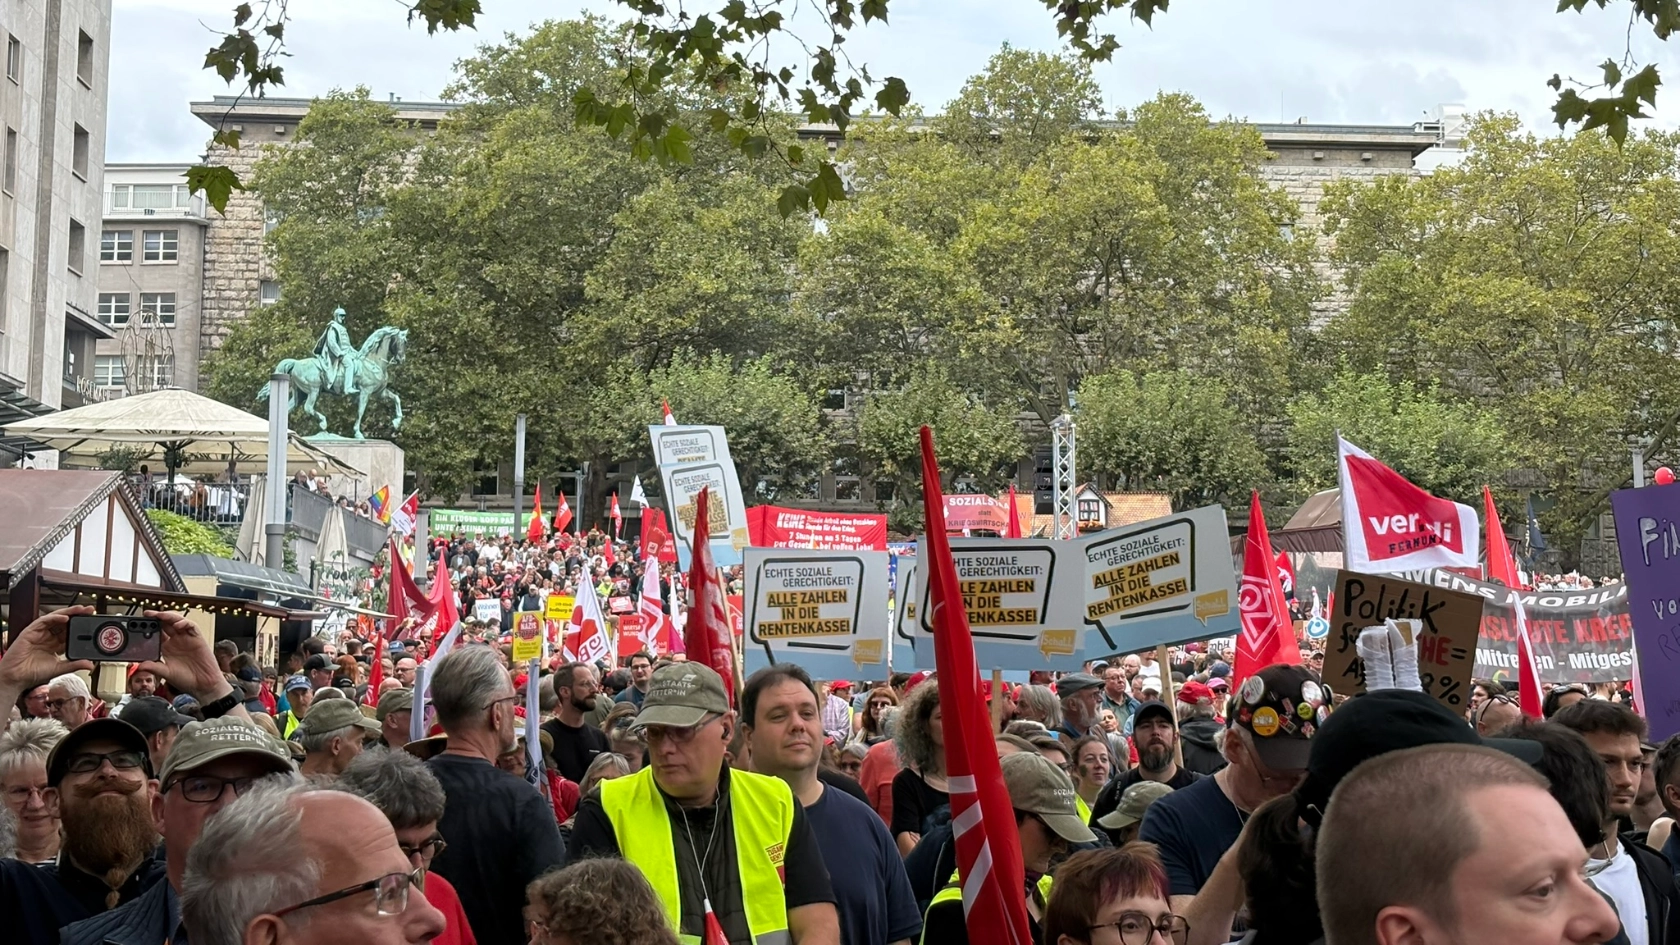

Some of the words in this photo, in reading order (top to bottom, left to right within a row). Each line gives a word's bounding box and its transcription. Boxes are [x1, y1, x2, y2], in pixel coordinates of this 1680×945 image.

[662, 440, 679, 449] ECHTE
[680, 438, 698, 447] SOZIALE
[675, 477, 691, 487] ECHTE
[691, 473, 710, 483] SOZIALE
[841, 535, 861, 543] Tagen
[1088, 547, 1118, 563] ECHTE
[1120, 535, 1160, 553] SOZIALE
[1107, 538, 1185, 566] GERECHTIGKEIT:
[975, 556, 1018, 566] SOZIALE
[765, 568, 794, 578] ECHTE
[796, 566, 832, 577] SOZIALE
[960, 566, 1043, 577] GERECHTIGKEIT:
[1094, 567, 1125, 588] ALLE
[1127, 552, 1180, 577] ZAHLEN
[782, 576, 854, 588] GERECHTIGKEIT:
[960, 582, 976, 596] LE
[979, 580, 1034, 593] ZAHLEN
[1110, 583, 1124, 597] IN
[1128, 575, 1150, 592] DIE
[767, 592, 798, 606] ALLE
[800, 590, 847, 604] ZAHLEN
[977, 596, 1001, 608] DIE
[1087, 579, 1188, 618] RENTENKASSE!
[781, 607, 795, 620] IN
[799, 606, 819, 619] DIE
[1344, 578, 1445, 634] Politik
[480, 611, 489, 619] für
[758, 619, 850, 636] RENTENKASSE!
